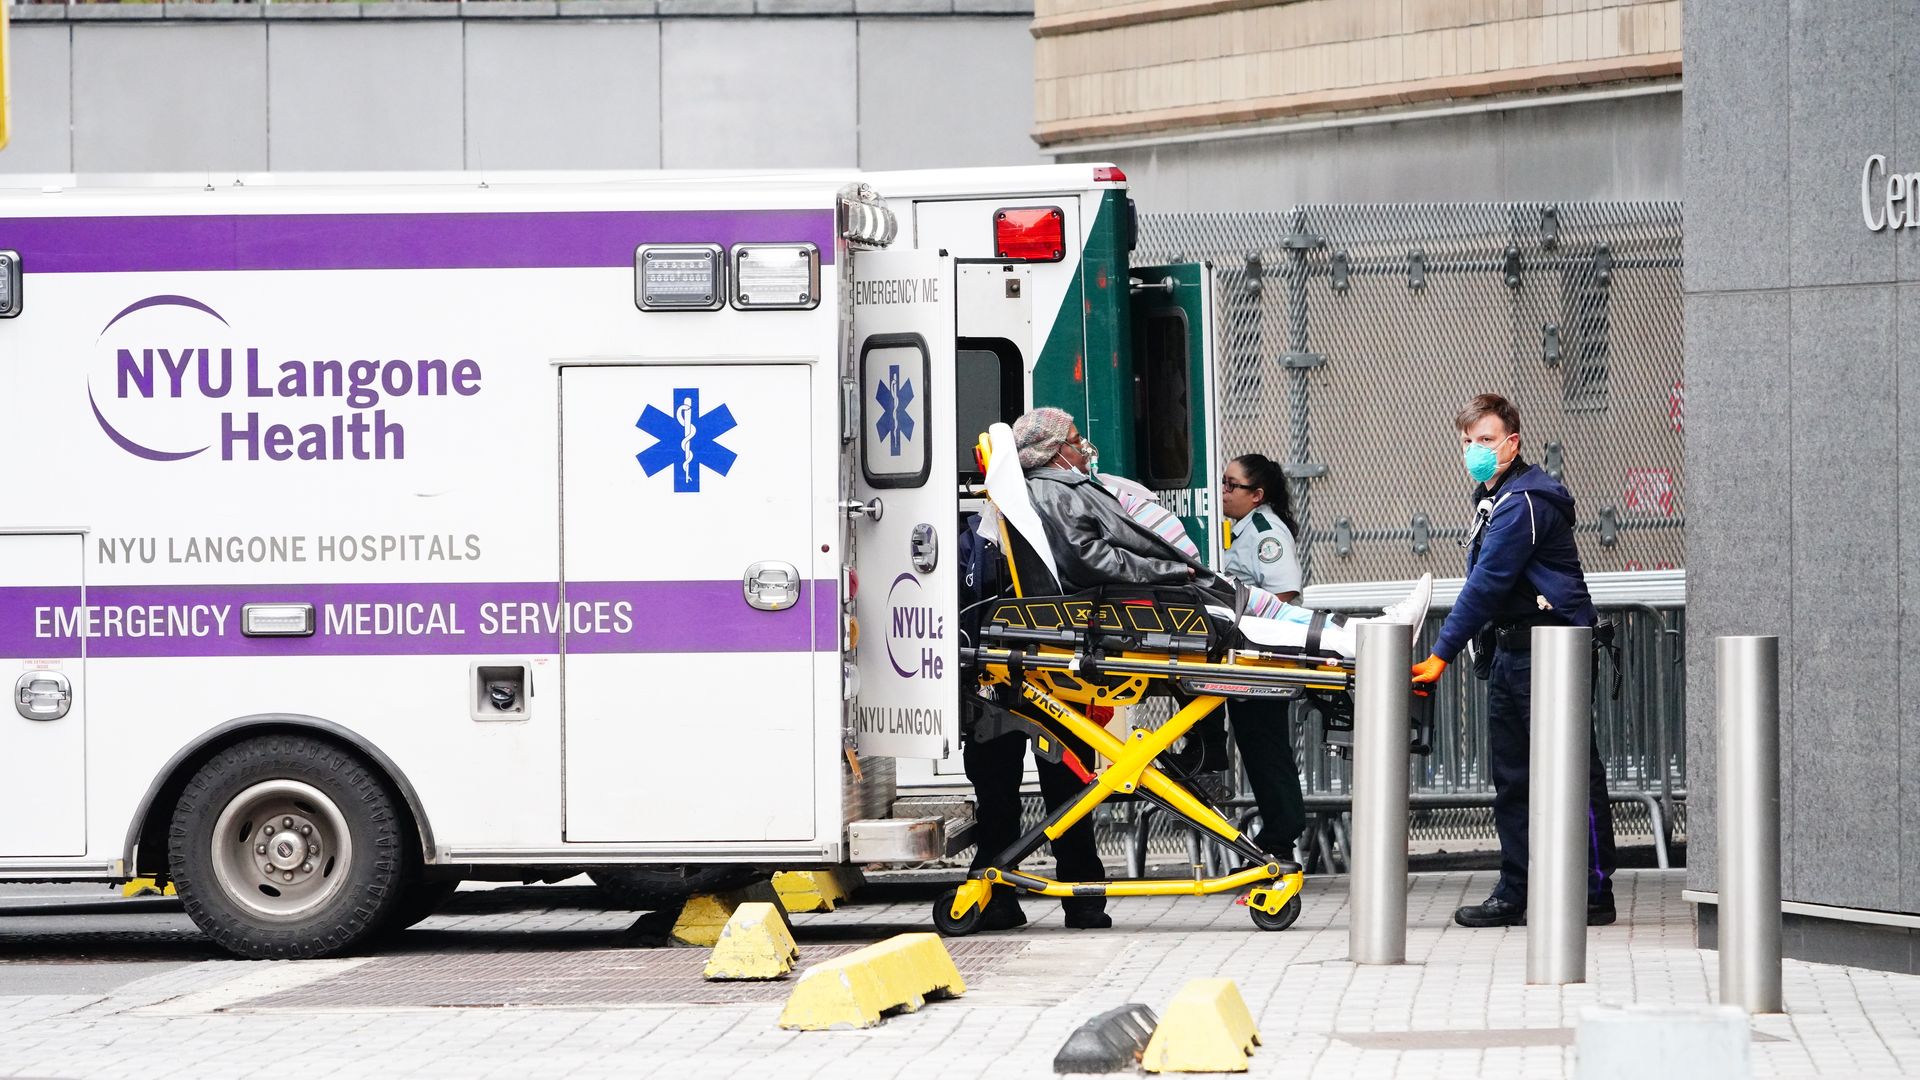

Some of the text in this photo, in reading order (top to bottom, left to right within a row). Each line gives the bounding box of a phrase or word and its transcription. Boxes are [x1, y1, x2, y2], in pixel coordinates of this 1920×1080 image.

[1862, 154, 1920, 231] Cen
[856, 277, 938, 305] EMERGENCY ME
[116, 348, 482, 409] NYU Langone
[221, 408, 405, 461] Health
[1152, 487, 1208, 517] ERGENCY ME
[98, 533, 481, 564] NYU LANGONE HOSPITALS
[35, 600, 633, 639] EMERGENCY MEDICAL SERVICES
[893, 606, 925, 639] NYU
[1076, 608, 1107, 620] XS
[921, 647, 943, 680] He
[859, 706, 942, 736] NYU LANGON
